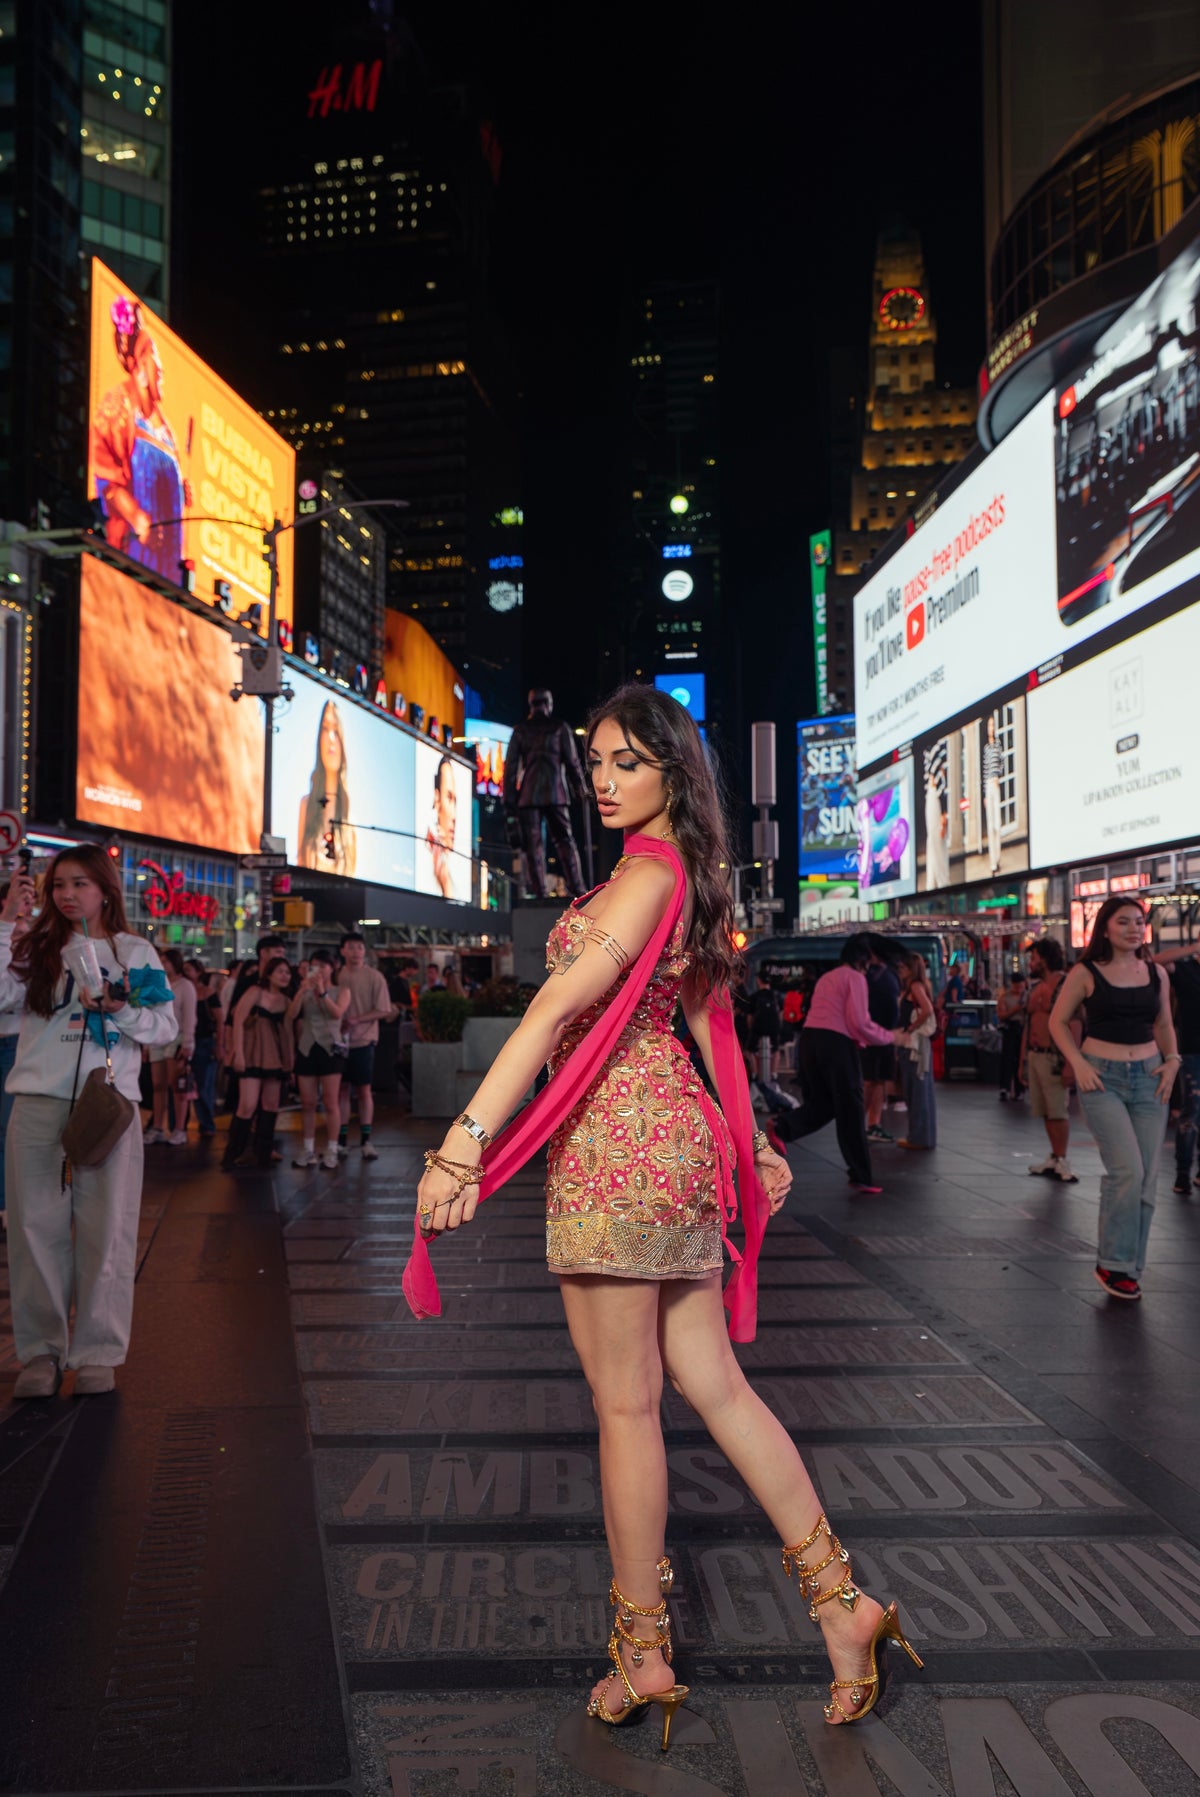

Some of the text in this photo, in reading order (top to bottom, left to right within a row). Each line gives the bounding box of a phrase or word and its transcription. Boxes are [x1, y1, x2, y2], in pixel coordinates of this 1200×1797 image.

[307, 58, 384, 118] H&M
[201, 402, 276, 489] BUENA
[201, 437, 274, 533] VISTA
[299, 500, 317, 514] LG
[886, 588, 902, 620] like
[953, 493, 1005, 569] podcasts
[887, 631, 903, 664] love
[926, 567, 980, 634] Premium
[807, 746, 844, 776] SEE
[1125, 764, 1183, 794] COLLECTION
[342, 1446, 1130, 1516] AMBSADOR
[355, 1549, 683, 1600] CIRCL
[364, 1599, 699, 1650] IN THE SQUE
